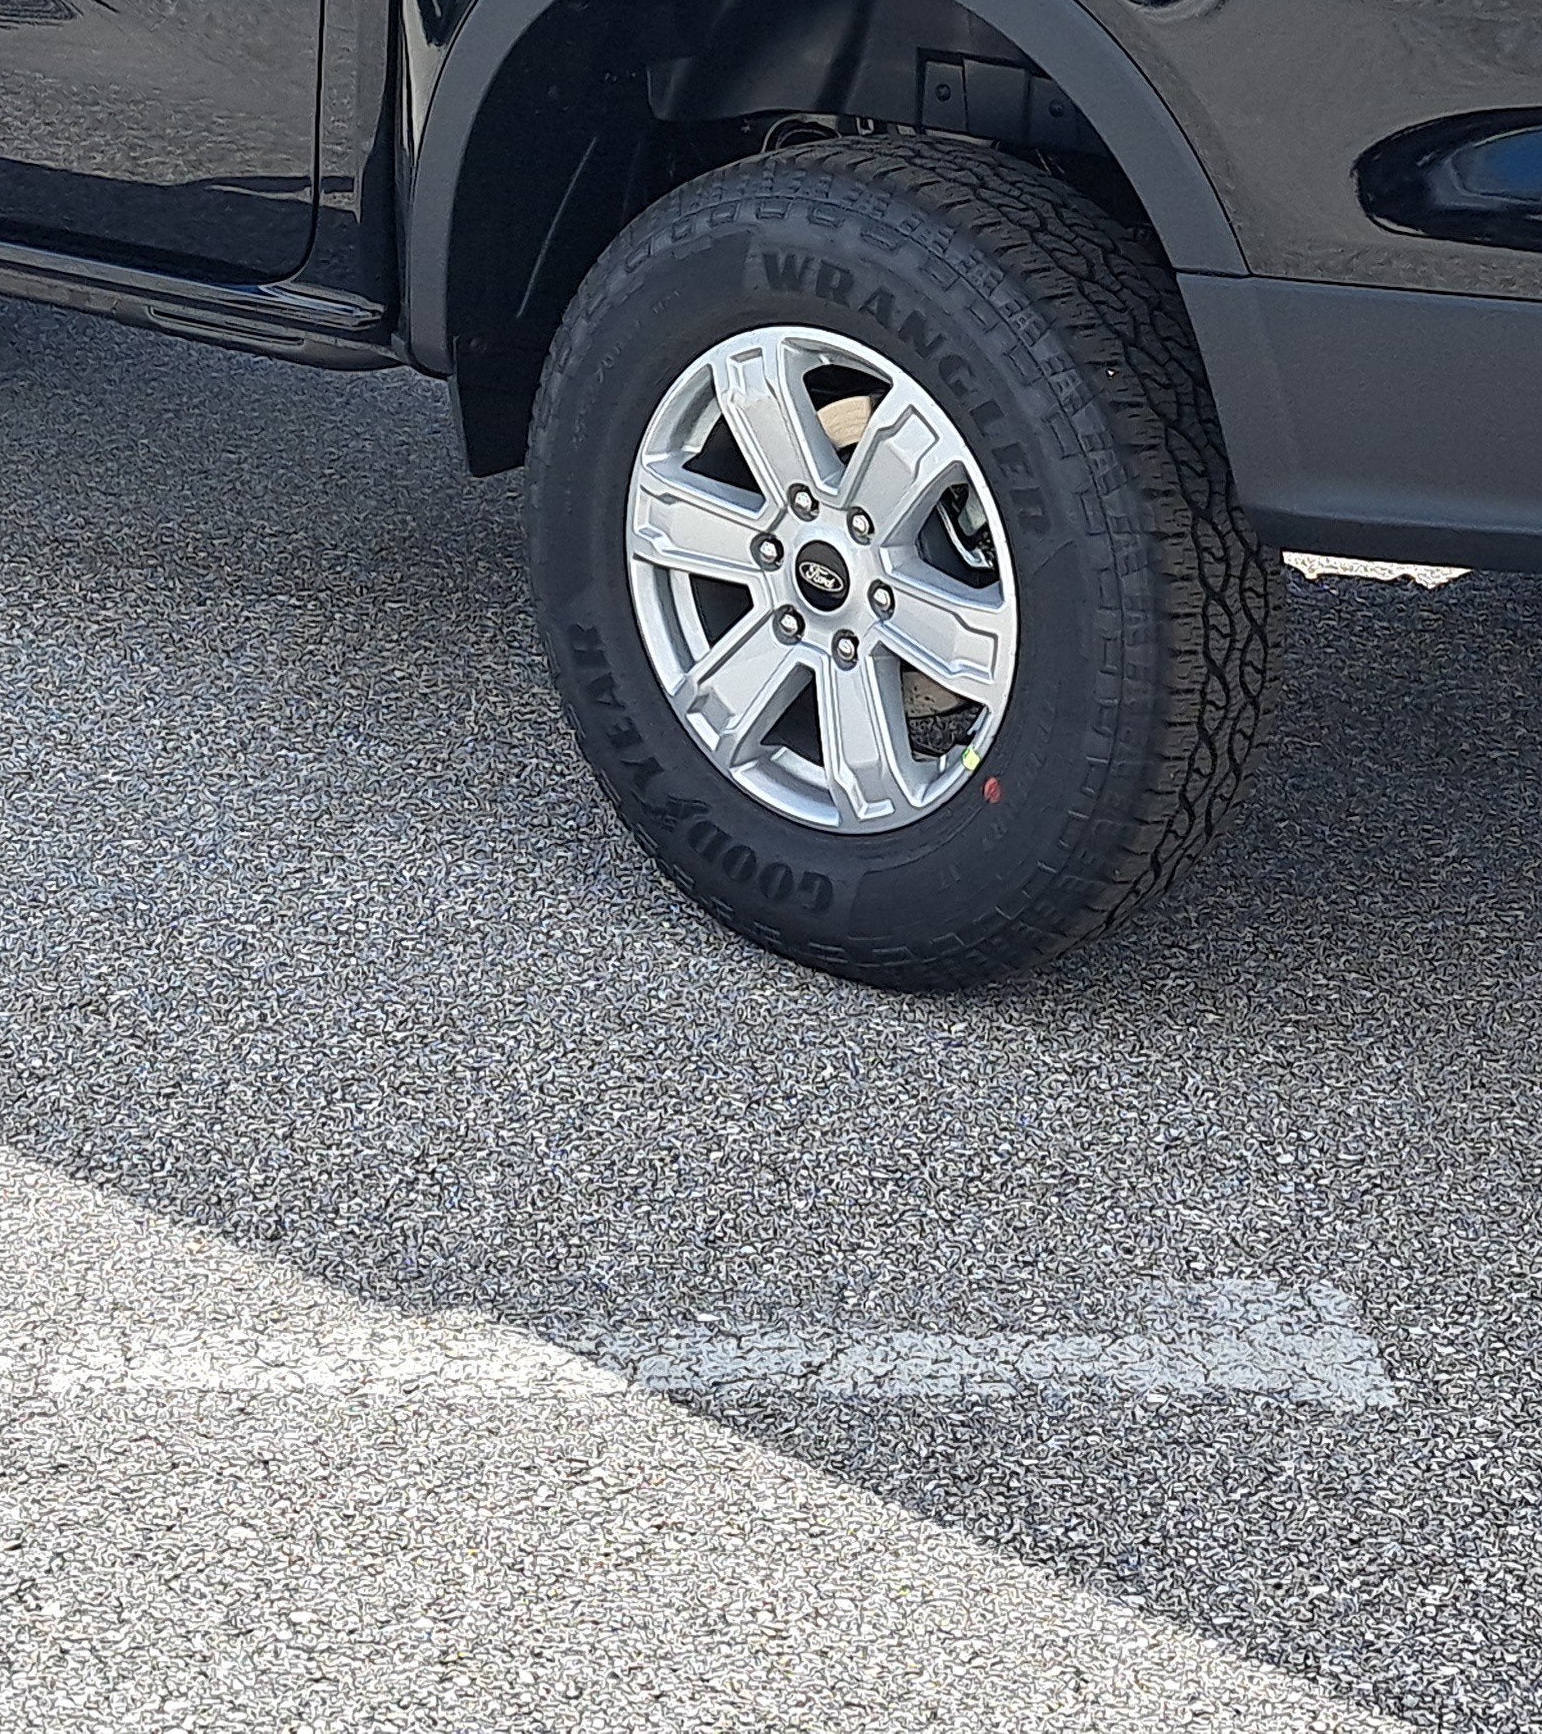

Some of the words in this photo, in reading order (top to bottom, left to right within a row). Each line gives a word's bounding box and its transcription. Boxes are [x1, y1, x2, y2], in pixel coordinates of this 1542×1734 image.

[762, 250, 1053, 534] WRANGLER
[803, 563, 838, 588] Ford
[566, 622, 835, 917] GOODYEAR
